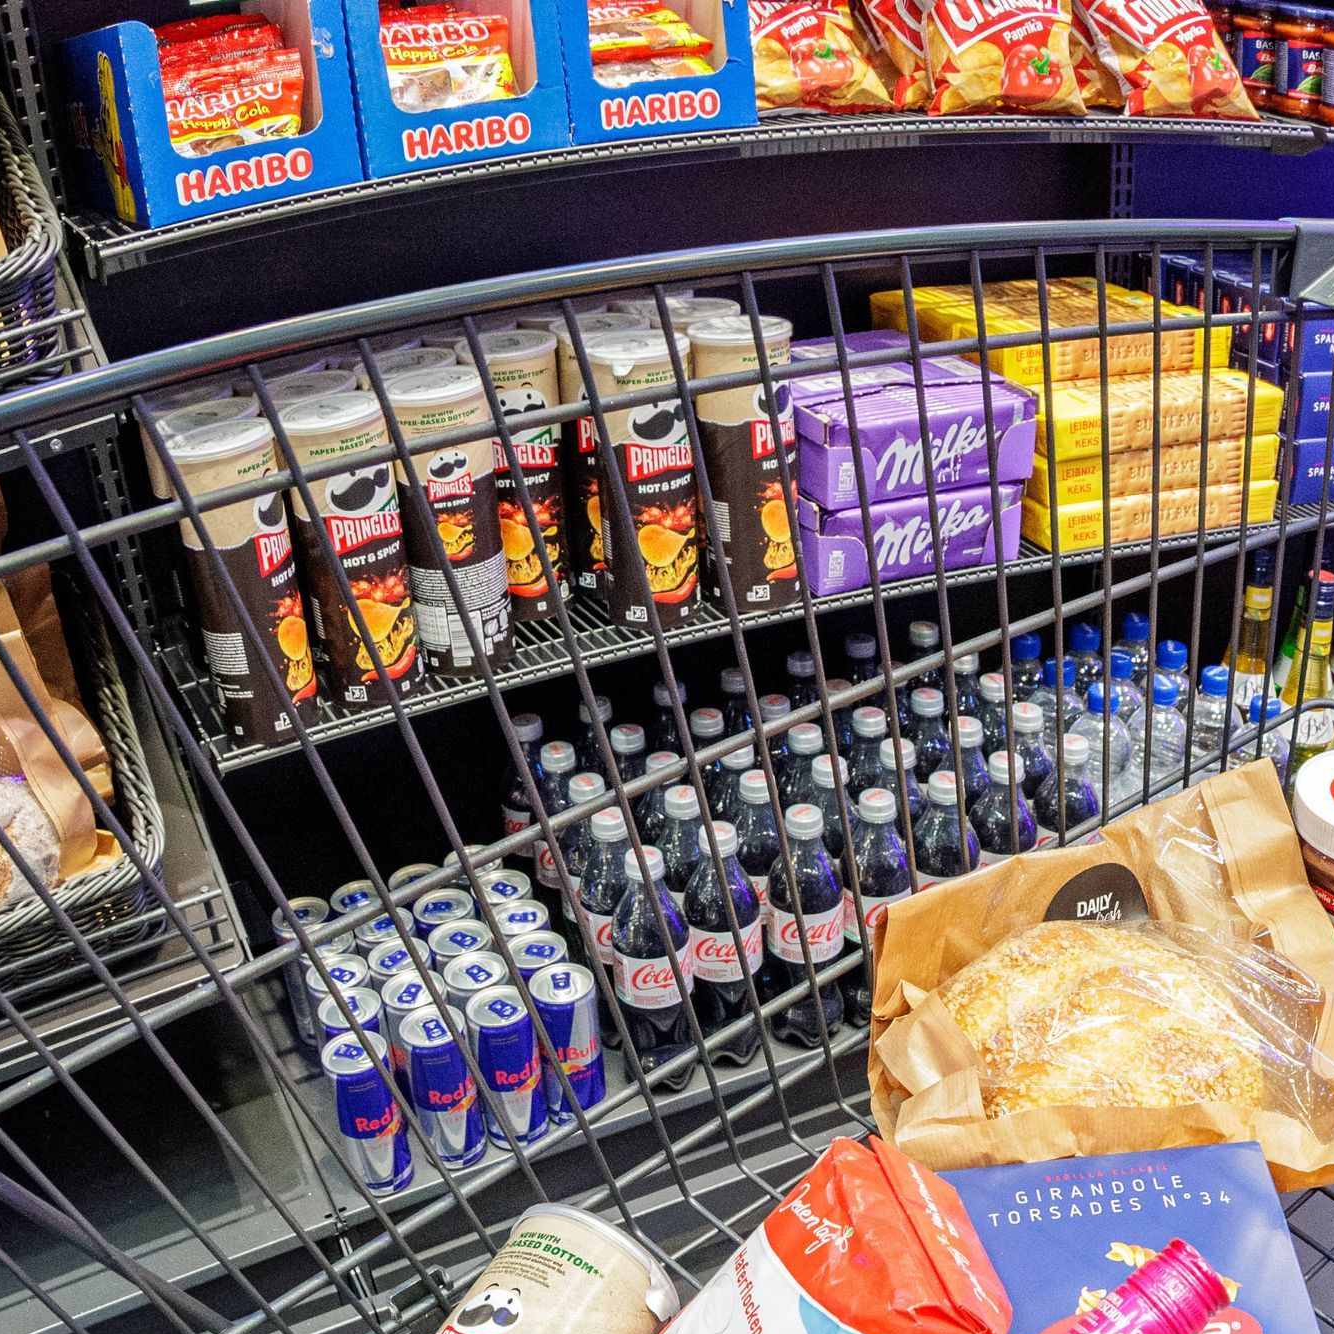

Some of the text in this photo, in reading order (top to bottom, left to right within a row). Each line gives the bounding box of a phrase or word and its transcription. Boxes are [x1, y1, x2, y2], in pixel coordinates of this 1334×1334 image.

[779, 14, 818, 39] Paprika
[1003, 20, 1044, 44] Paprika
[1174, 24, 1207, 46] Paprika
[601, 88, 720, 130] HARIBO
[403, 113, 531, 160] HARIBO
[176, 148, 314, 206] HARIBO
[1017, 348, 1043, 362] LEIBN
[1069, 419, 1102, 434] LEIBNIZ
[309, 440, 364, 457] PAPER-BASED
[874, 414, 1004, 492] Milka
[1075, 436, 1100, 449] KEKS
[630, 443, 692, 476] PRINGLES
[637, 482, 661, 495] HOT
[670, 473, 692, 490] SPICY
[1061, 465, 1097, 481] LEIBNIZ
[429, 477, 473, 500] PRINGLES
[1067, 483, 1092, 494] KEKS
[452, 497, 470, 507] SPICY
[1068, 512, 1102, 528] LEIBNIZ
[330, 512, 400, 552] PRINGLES
[872, 498, 991, 569] Milka
[1073, 530, 1098, 541] KEKS
[259, 528, 292, 572] PRIN
[342, 556, 366, 569] HOT
[376, 541, 401, 560] SPICY
[1076, 892, 1113, 917] DAILY
[495, 1063, 532, 1086] Red
[428, 1086, 466, 1106] Red
[354, 1111, 391, 1133] Red
[1014, 1174, 1185, 1206] GIRANDOLE
[987, 1190, 1233, 1228] TORSADES N°34
[536, 1232, 562, 1245] WITH
